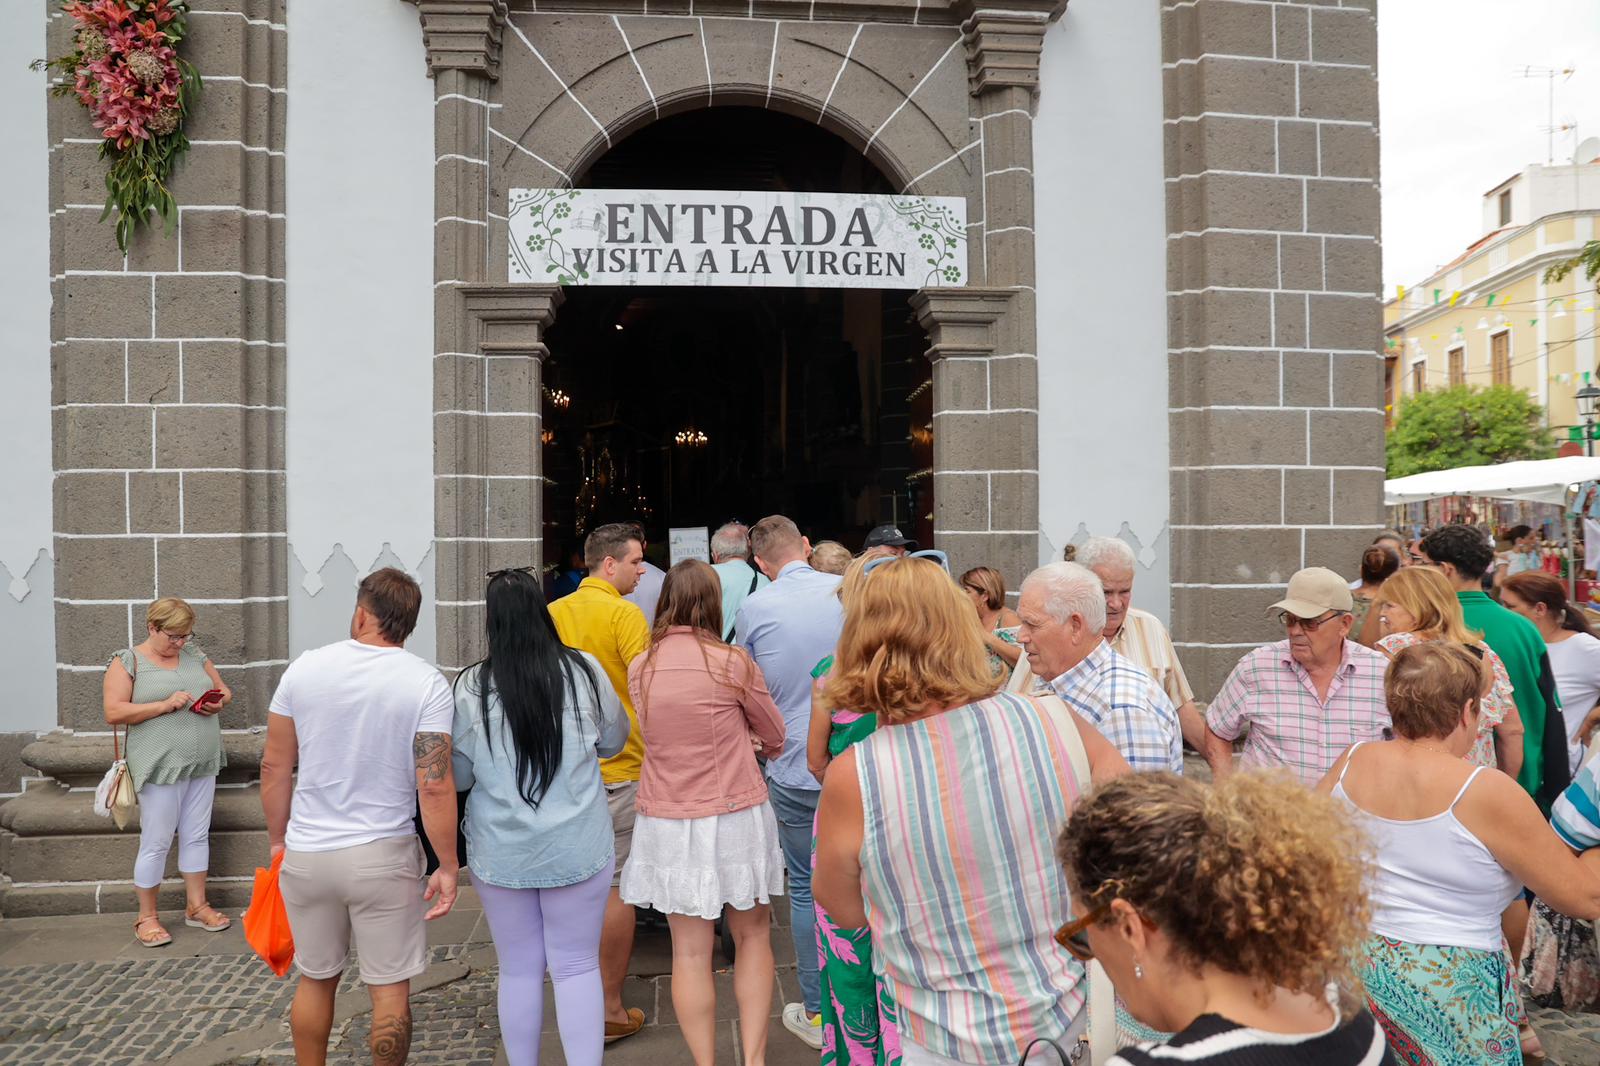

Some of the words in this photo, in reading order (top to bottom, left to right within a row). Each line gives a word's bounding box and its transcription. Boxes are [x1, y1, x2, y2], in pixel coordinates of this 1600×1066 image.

[605, 203, 878, 246] ENTRADA
[573, 247, 687, 274] VISITA
[697, 250, 719, 273] A
[730, 250, 772, 274] LA
[782, 250, 906, 276] VIRGEN
